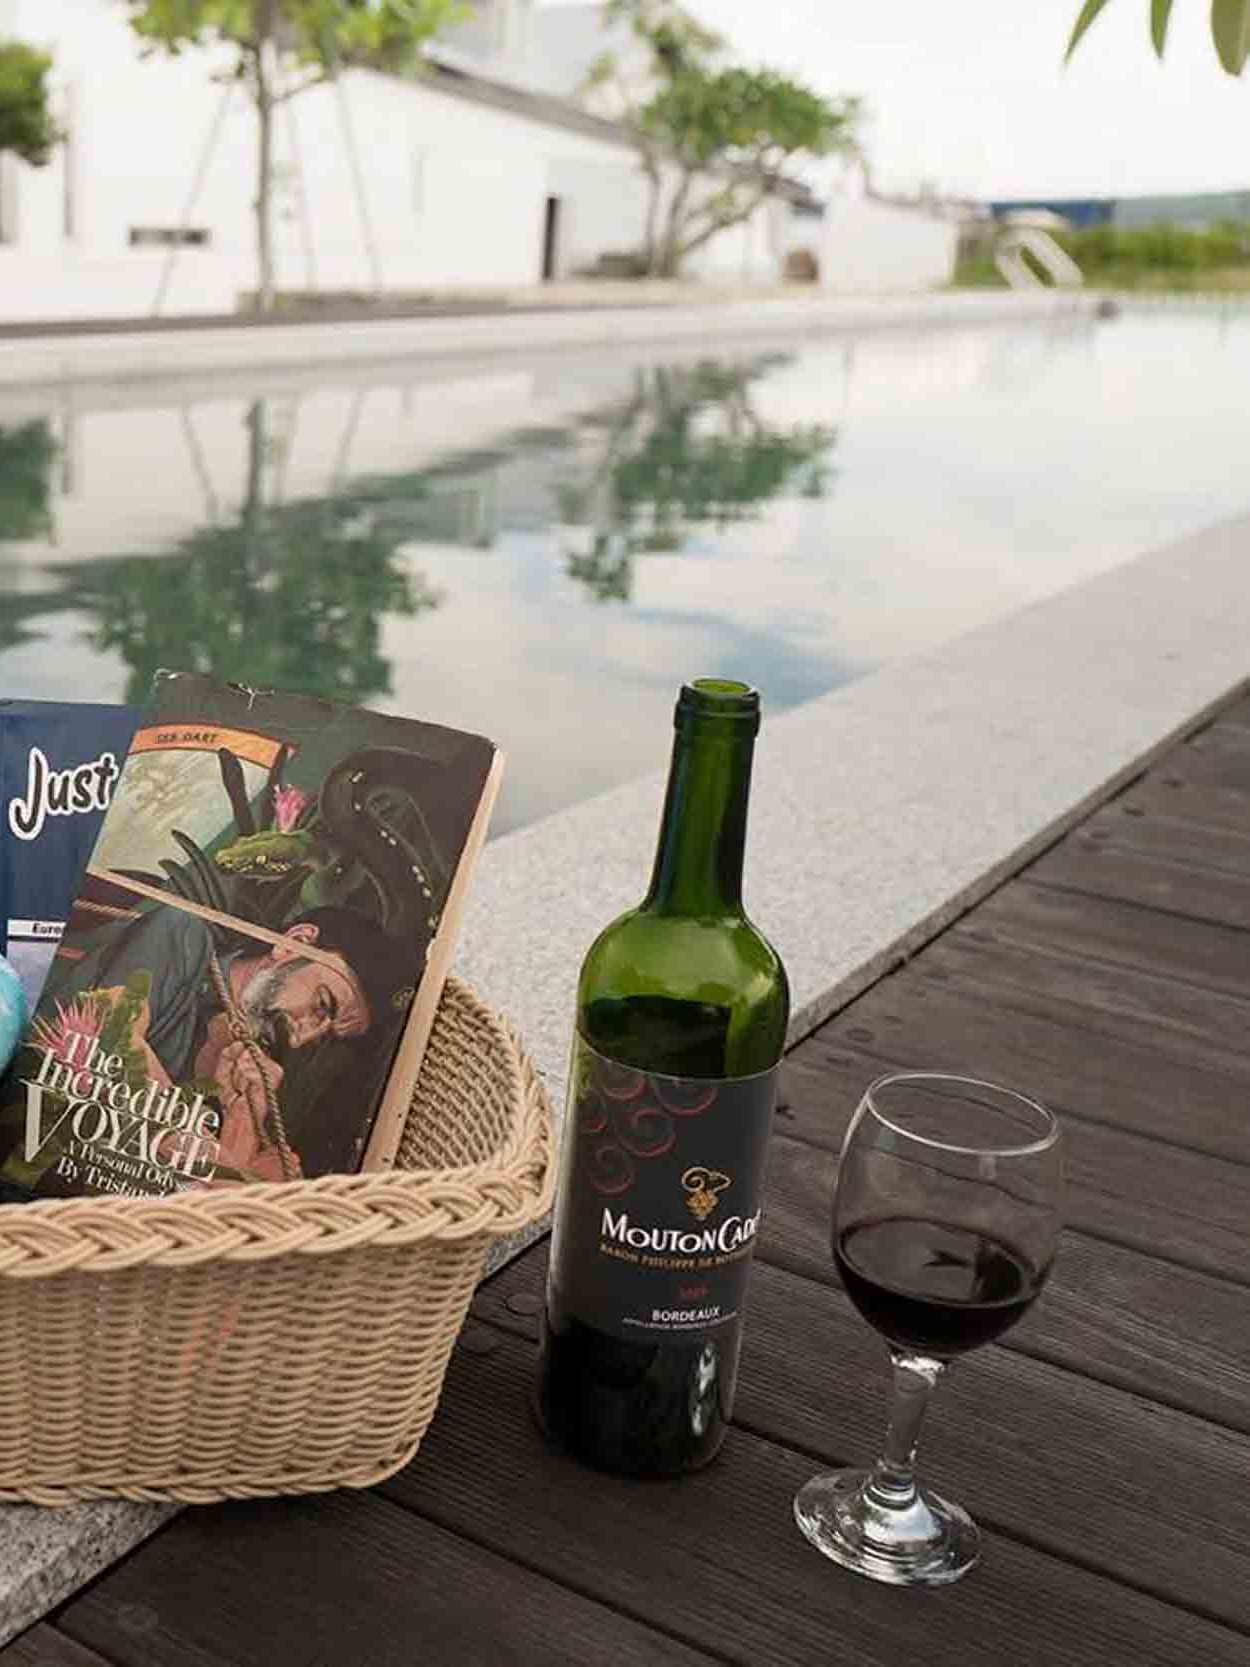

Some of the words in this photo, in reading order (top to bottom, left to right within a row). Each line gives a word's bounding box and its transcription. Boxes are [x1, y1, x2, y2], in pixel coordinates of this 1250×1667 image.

[9, 747, 119, 840] Just
[62, 1031, 124, 1078] The
[35, 1048, 220, 1140] Incredible
[19, 1078, 221, 1183] VOYAGE
[57, 1156, 78, 1183] By
[651, 1305, 720, 1322] BORDEAUX
